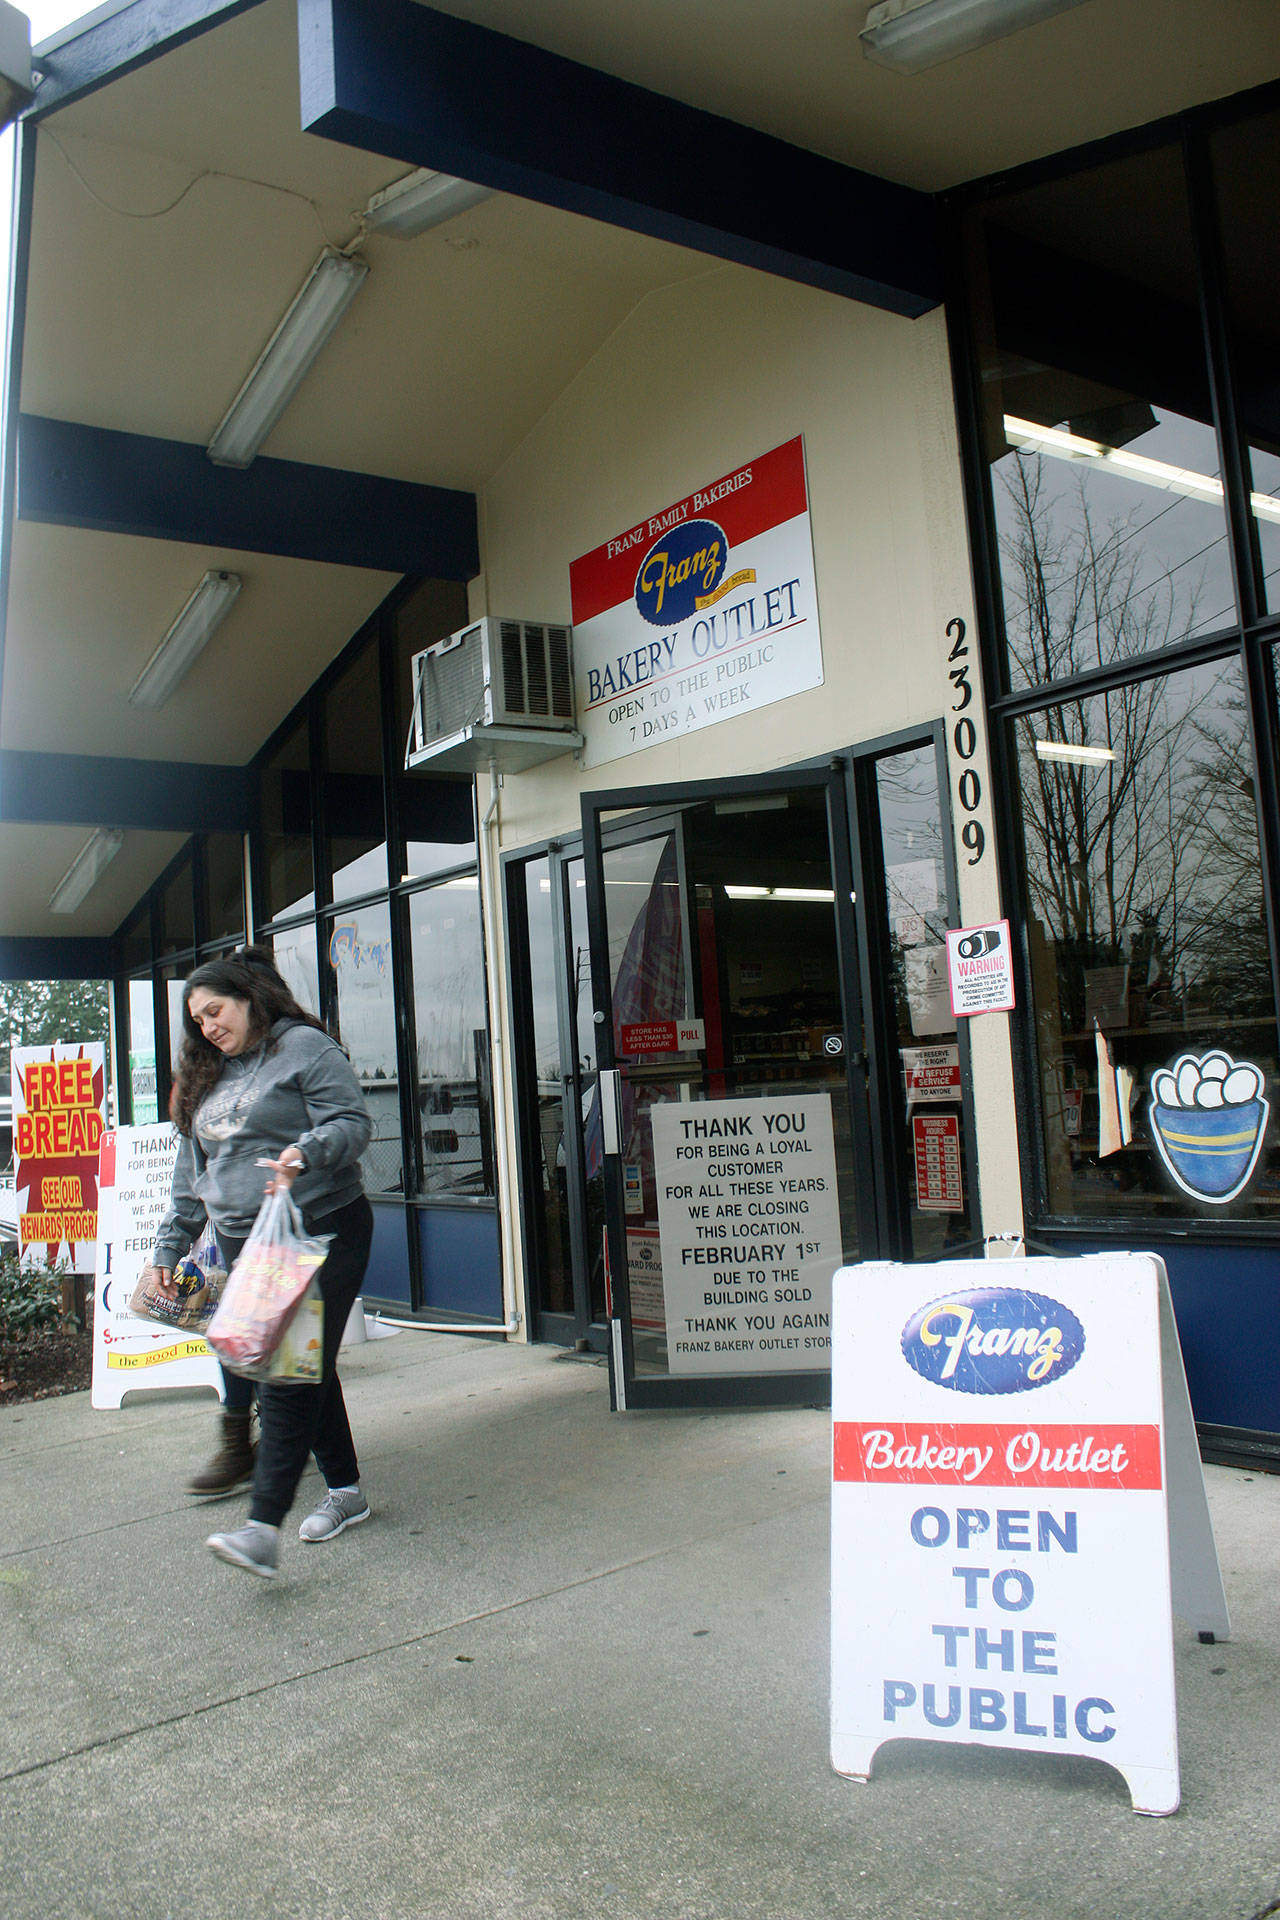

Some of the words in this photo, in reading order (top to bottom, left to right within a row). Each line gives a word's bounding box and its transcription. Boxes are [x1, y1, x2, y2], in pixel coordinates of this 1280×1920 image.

[606, 528, 645, 559] FRANZ
[648, 502, 689, 537] FAMILY
[692, 468, 753, 512] BAKERIES
[641, 541, 721, 614] Franz
[731, 570, 750, 584] bread
[587, 632, 678, 703] BAKERY
[691, 578, 800, 657] OUTLET
[609, 697, 644, 724] OPEN
[651, 687, 670, 707] TO
[677, 671, 709, 697] THE
[716, 645, 774, 682] PUBLIC
[629, 727, 636, 742] 7
[643, 711, 678, 738] DAYS
[685, 706, 697, 722] A
[704, 683, 750, 714] WEEK
[946, 617, 985, 865] 23009
[957, 955, 1005, 976] WARNING
[680, 1029, 699, 1040] PULL
[924, 1050, 949, 1058] RESERVE
[930, 1057, 947, 1065] RIGHT
[919, 1077, 950, 1086] SERVICE
[925, 1068, 953, 1077] REFUSE
[25, 1060, 94, 1110] FREE
[17, 1108, 103, 1159] BREAD
[680, 1116, 753, 1139] THANK
[763, 1113, 806, 1134] YOU
[132, 1136, 177, 1155] THANK
[676, 1146, 703, 1159] FOR
[708, 1143, 750, 1158] BEING
[755, 1142, 765, 1155] A
[770, 1139, 813, 1154] LOYAL
[128, 1160, 144, 1170] FOR
[148, 1156, 174, 1168] BEING
[707, 1161, 783, 1178] CUSTOMER
[42, 1176, 61, 1208] SEE
[61, 1175, 82, 1208] OUR
[119, 1190, 136, 1201] FOR
[139, 1188, 155, 1199] ALL
[665, 1185, 693, 1199] FOR
[699, 1184, 724, 1198] ALL
[729, 1181, 774, 1196] THESE
[779, 1178, 829, 1193] YEARS.
[132, 1205, 145, 1216] WE
[149, 1203, 166, 1214] ARE
[688, 1205, 710, 1219] WE
[716, 1204, 742, 1218] ARE
[747, 1200, 809, 1216] CLOSING
[20, 1213, 62, 1243] REWARDS
[135, 1220, 155, 1231] THIS
[696, 1224, 727, 1239] THIS
[732, 1221, 804, 1237] LOCATION.
[681, 1244, 786, 1265] FEBRUARY
[795, 1243, 821, 1260] 1ST
[713, 1271, 742, 1285] DUE
[747, 1270, 766, 1284] TO
[772, 1269, 800, 1282] THE
[703, 1290, 768, 1305] BUILDING
[774, 1288, 812, 1302] SOLD
[684, 1317, 737, 1332] THANK
[744, 1315, 775, 1330] YOU
[782, 1313, 830, 1329] AGAIN
[676, 1341, 710, 1352] FRANZ
[714, 1340, 754, 1351] BAKERY
[759, 1338, 799, 1349] OUTLET
[804, 1336, 832, 1348] STOR
[919, 1303, 1063, 1380] Franz
[119, 1356, 138, 1366] the
[145, 1345, 177, 1366] good
[862, 1430, 994, 1481] Bakery
[1005, 1431, 1129, 1473] Outlet
[910, 1506, 1079, 1554] OPEN
[952, 1566, 1035, 1612] TO
[931, 1624, 1058, 1676] THE
[883, 1679, 1117, 1743] PUBLIC
